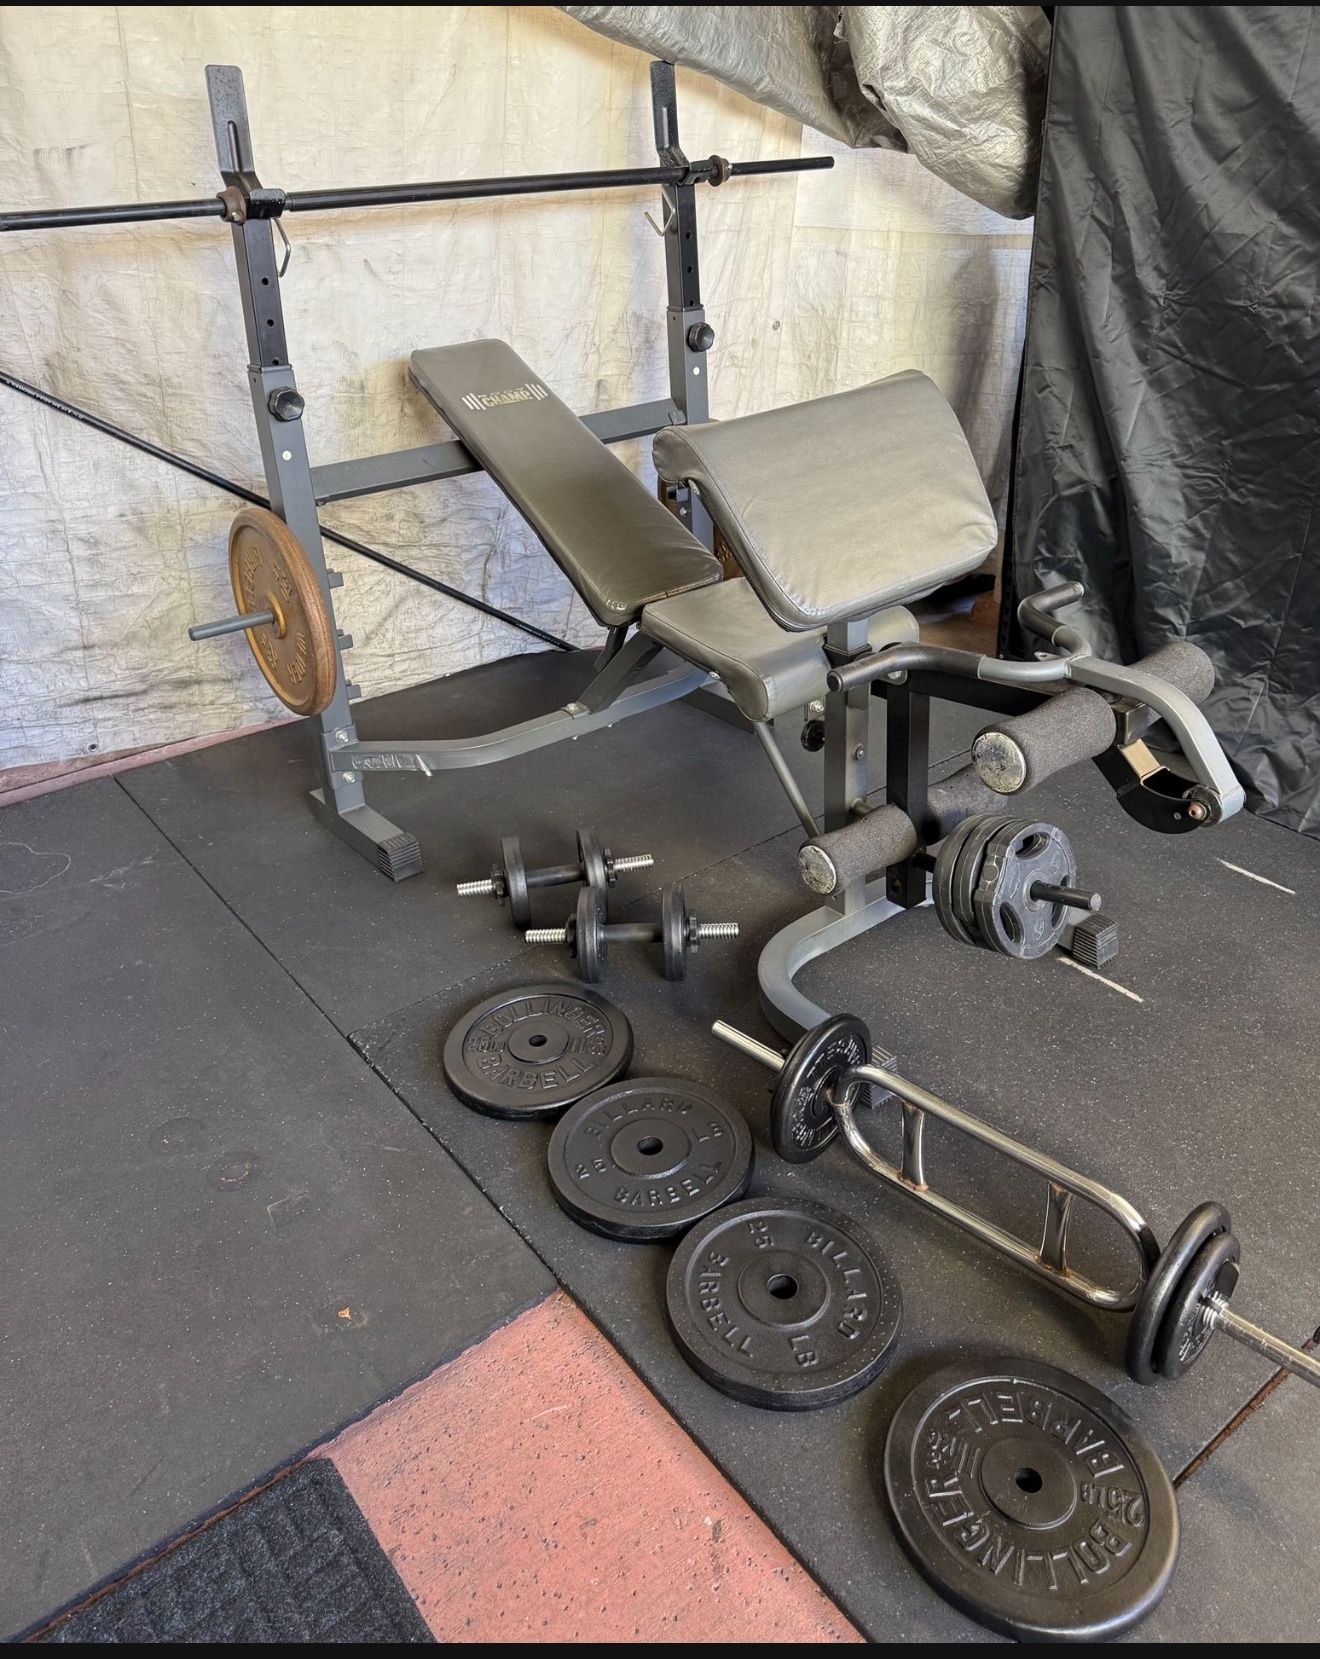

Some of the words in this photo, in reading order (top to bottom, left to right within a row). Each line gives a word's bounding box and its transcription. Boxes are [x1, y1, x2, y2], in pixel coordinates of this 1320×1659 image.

[480, 999, 606, 1038] BOLLINGER
[478, 1053, 595, 1089] BARBELL
[584, 1098, 693, 1137] BILLARD
[692, 1121, 724, 1143] LB
[575, 1158, 607, 1180] 25
[614, 1161, 722, 1207] BARBELL
[749, 1221, 776, 1249] 25
[699, 1252, 754, 1358] BARBELL
[805, 1232, 867, 1339] BILLARD
[790, 1335, 818, 1368] LB
[949, 1393, 1126, 1478] BARBELL
[926, 1477, 1133, 1590] BOLLINGER
